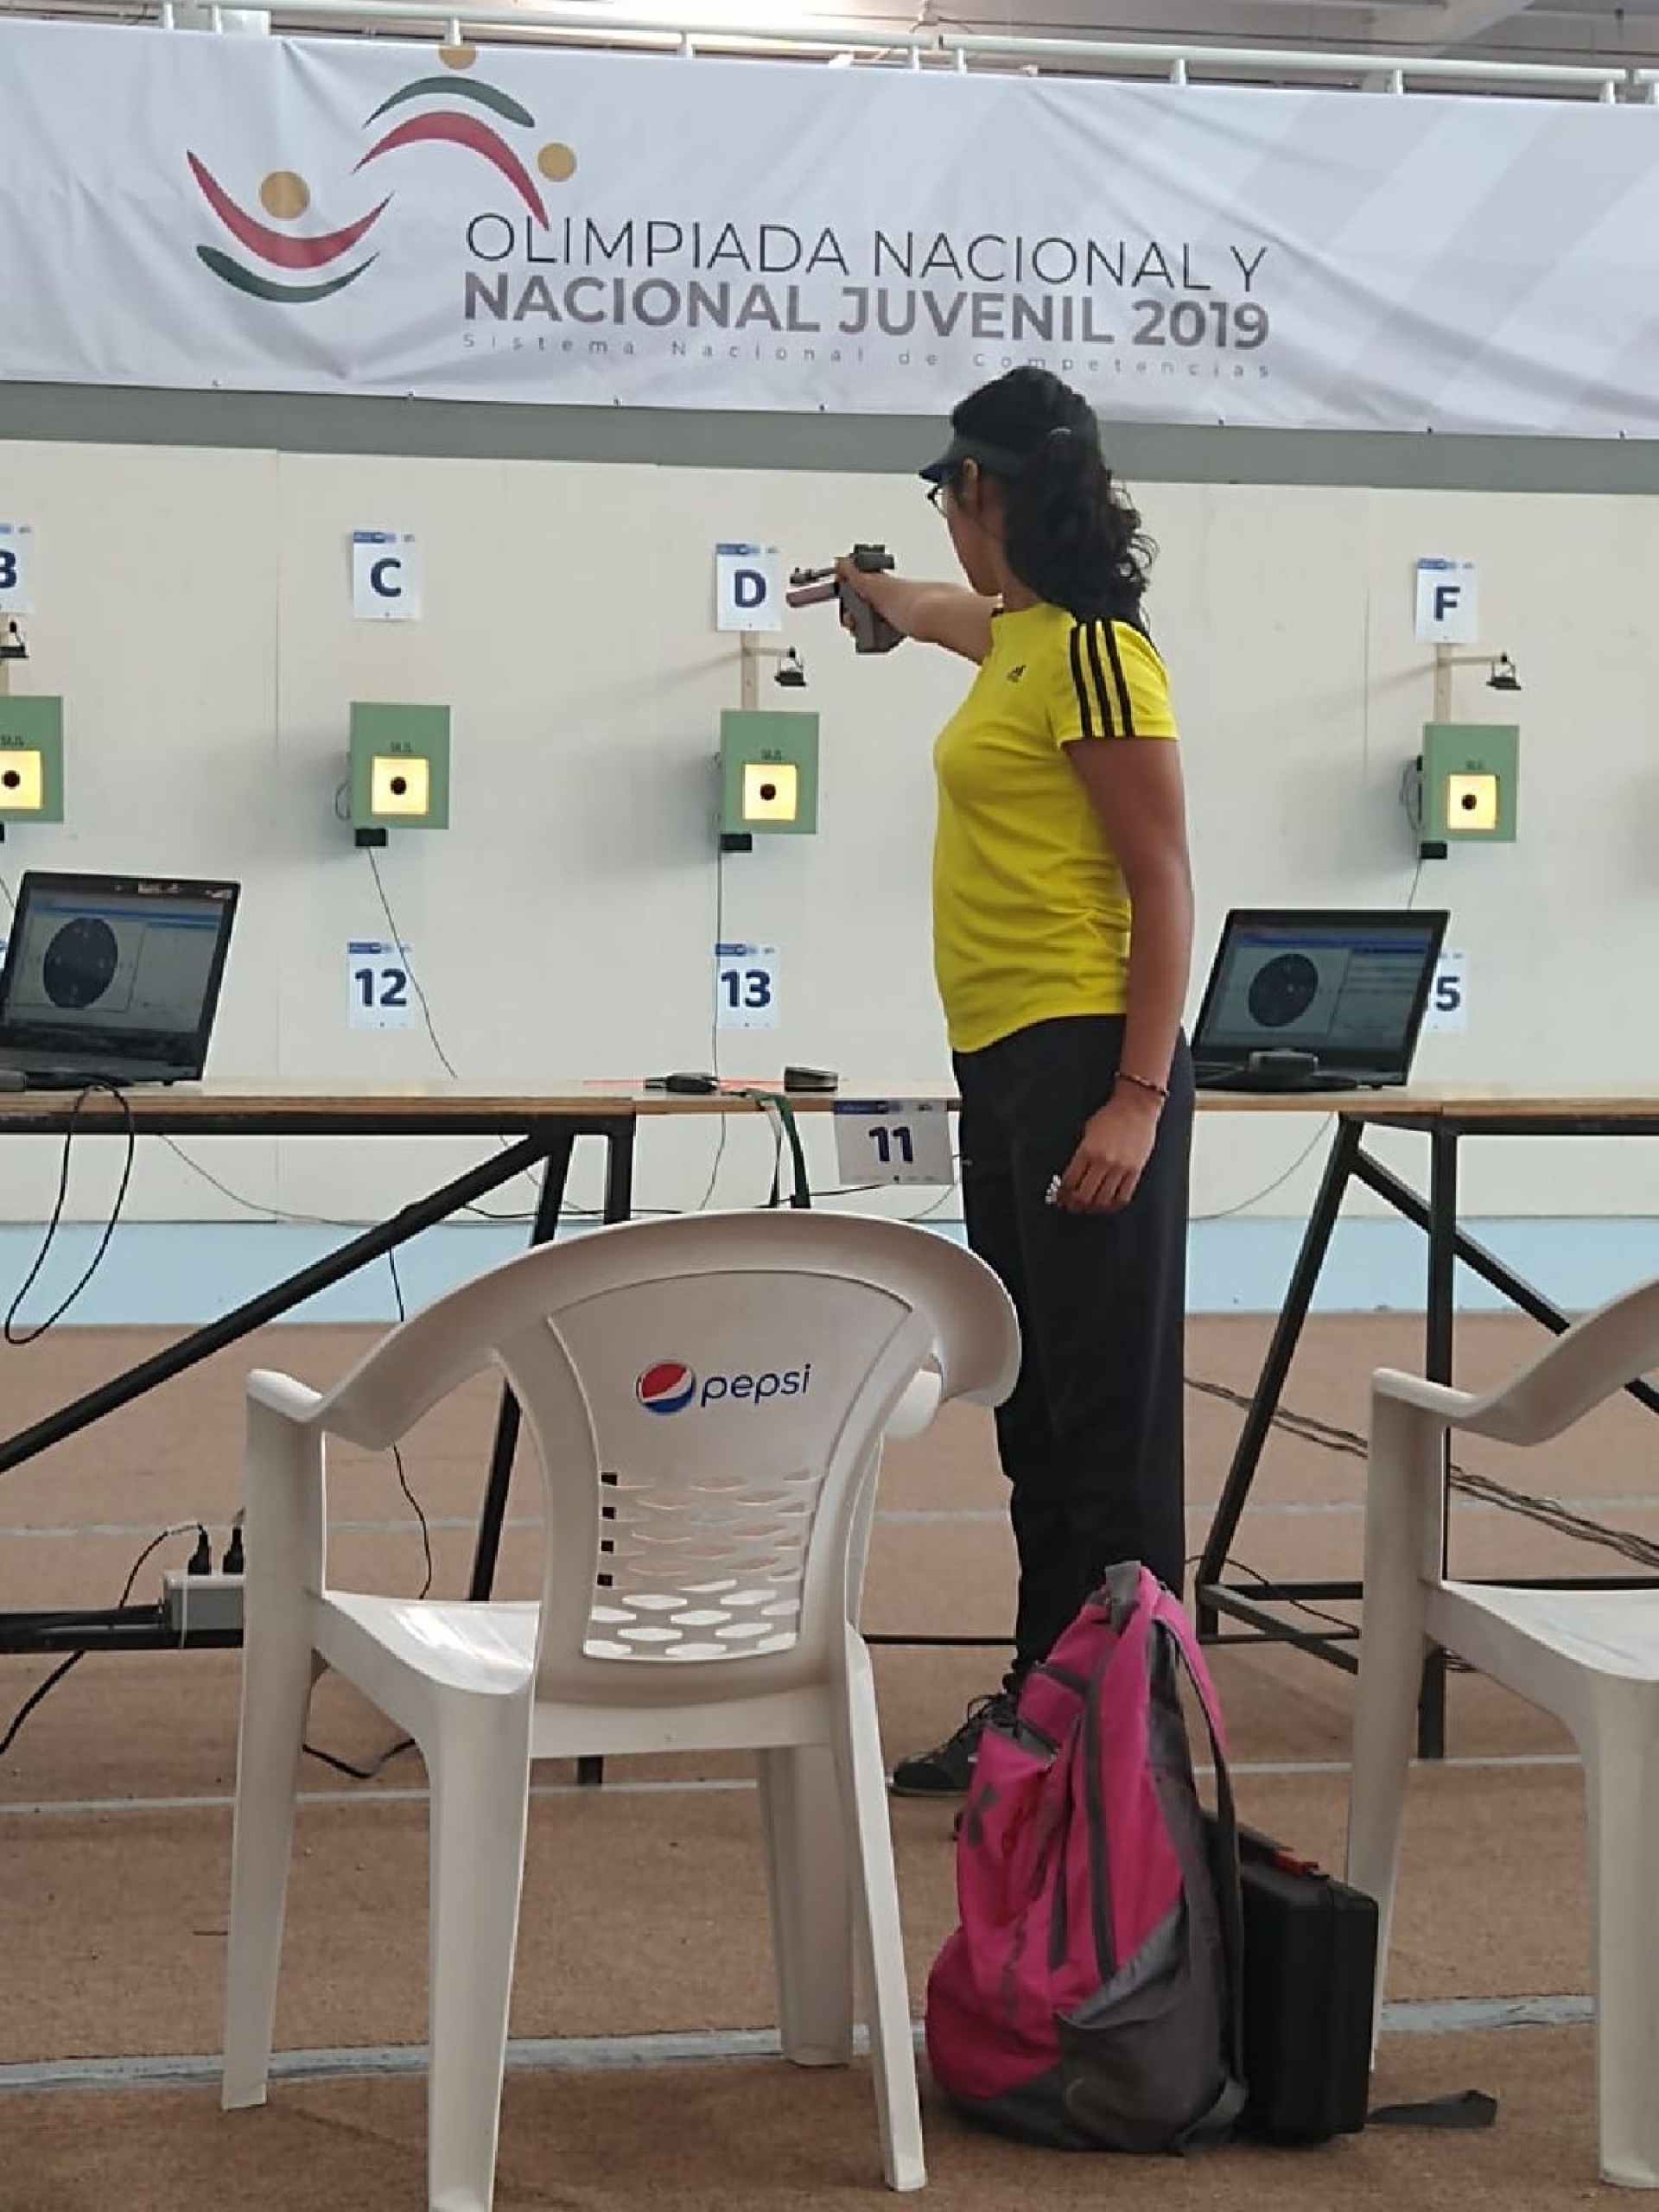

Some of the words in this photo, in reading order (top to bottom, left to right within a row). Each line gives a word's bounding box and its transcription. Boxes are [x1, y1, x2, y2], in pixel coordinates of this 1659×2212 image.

[467, 213, 849, 276] OLIMPIADA
[874, 230, 1212, 291] NACIONAL
[1230, 245, 1268, 292] Y
[465, 272, 820, 333] NACIONAL
[838, 287, 1115, 344] JUVENIL
[1132, 299, 1269, 349] 2019
[463, 334, 634, 354] Sistema
[671, 340, 864, 362] Nacional
[899, 349, 938, 366] de
[370, 557, 402, 598] C
[734, 569, 767, 608] D
[1435, 585, 1461, 621] F
[354, 968, 407, 1007] 12
[720, 969, 772, 1008] 13
[1436, 976, 1461, 1012] 5
[868, 1126, 914, 1162] 11
[700, 1363, 811, 1408] pepsi
